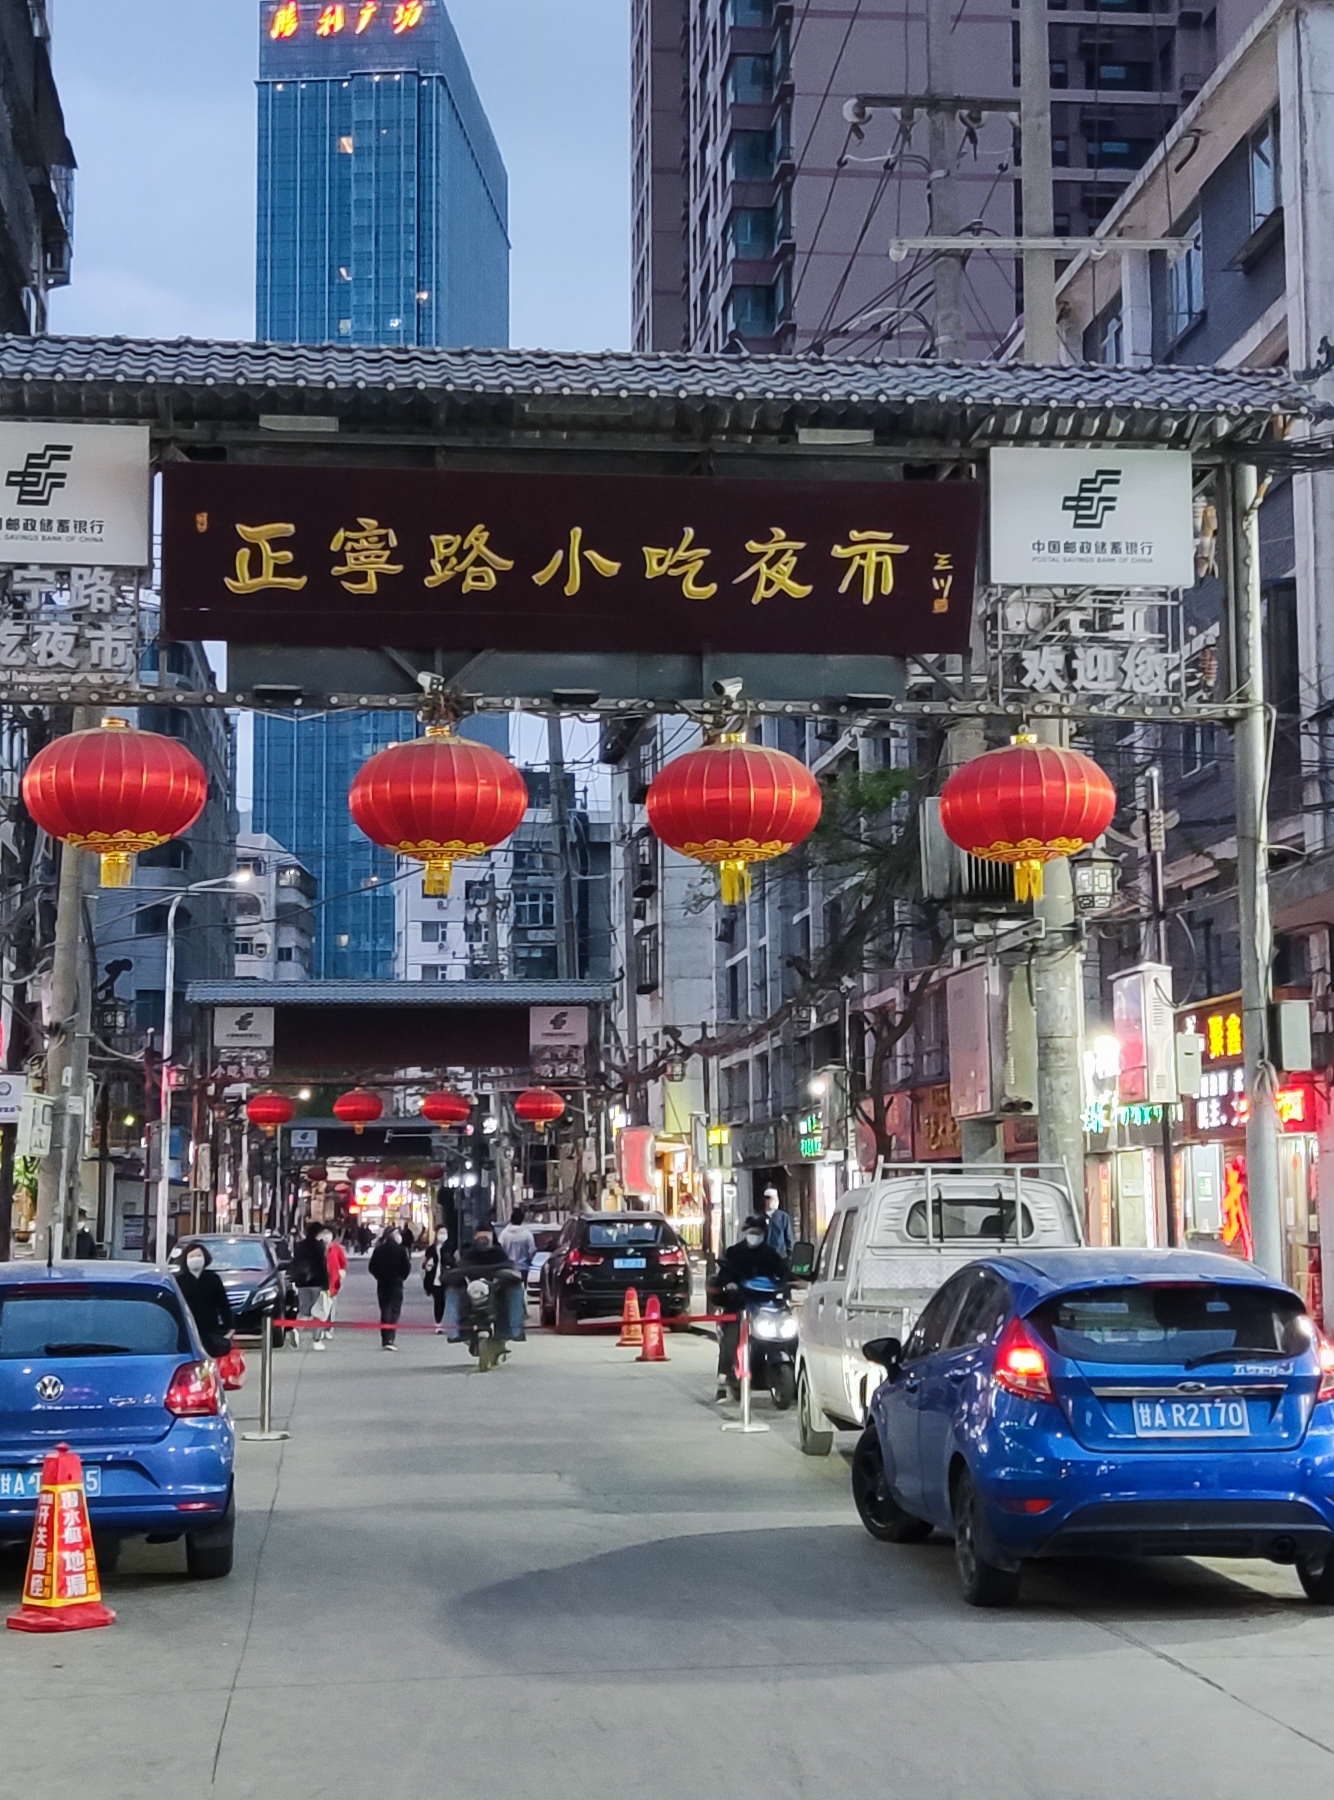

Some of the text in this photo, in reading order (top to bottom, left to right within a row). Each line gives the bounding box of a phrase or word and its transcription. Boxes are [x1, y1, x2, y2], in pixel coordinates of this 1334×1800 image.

[4, 533, 39, 542] SAVINGS
[41, 534, 63, 542] BANK
[79, 535, 104, 543] CHINA
[1031, 539, 1154, 556] 中国邮政储蓄银行
[1031, 556, 1154, 564] POSTAL SAVINGS BANK OF CHINA
[1020, 646, 1167, 694] 欢迎您
